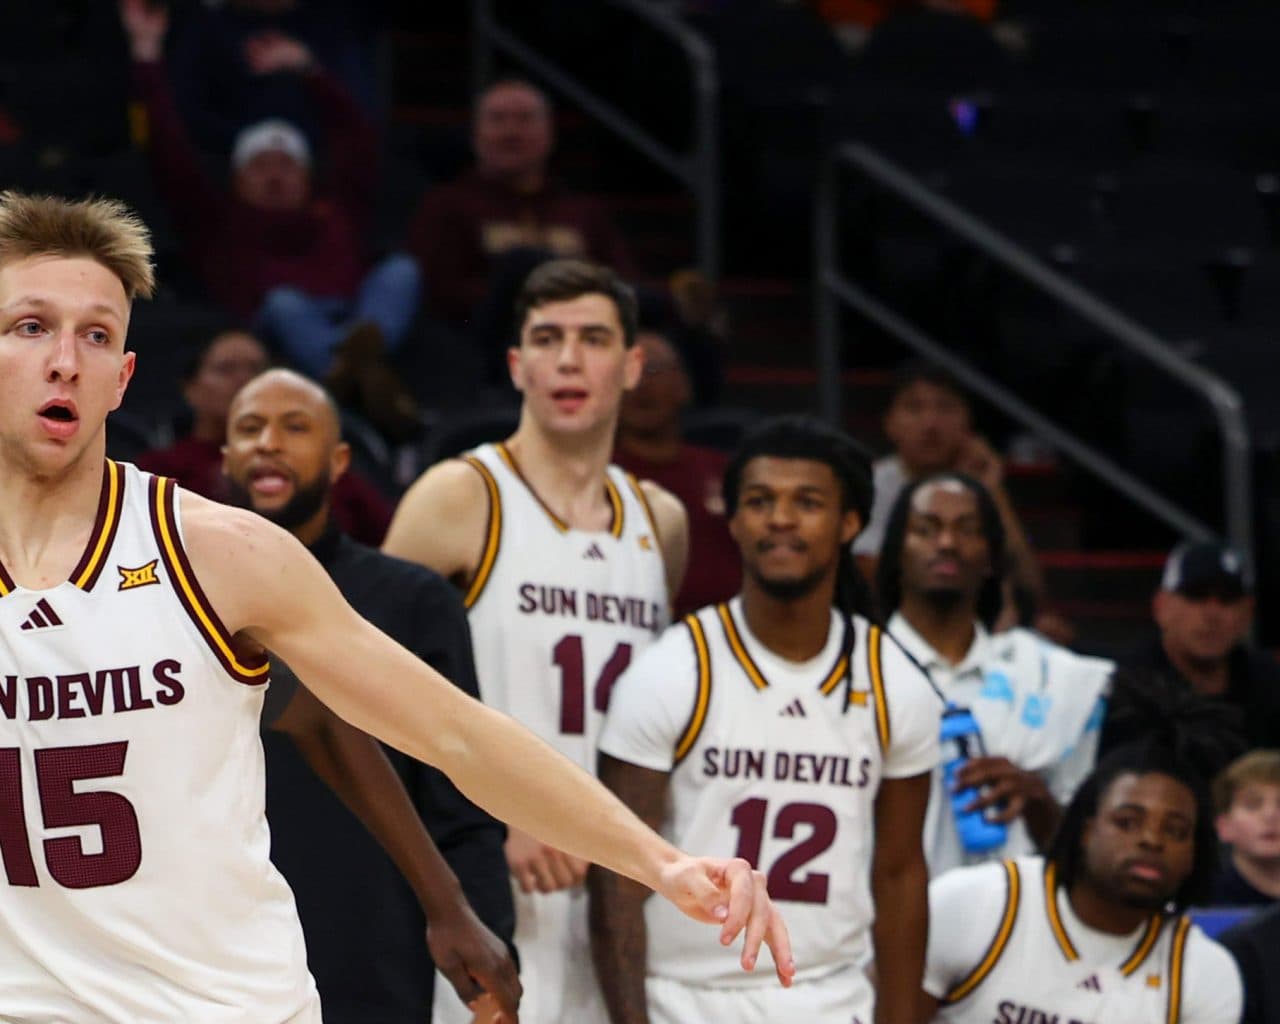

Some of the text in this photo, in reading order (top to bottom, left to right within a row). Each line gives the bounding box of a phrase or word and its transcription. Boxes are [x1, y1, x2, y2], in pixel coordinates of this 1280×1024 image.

[518, 583, 577, 618] SUN
[25, 659, 185, 721] DEVILS
[703, 747, 872, 788] SUN DEVILS
[730, 797, 837, 904] 12
